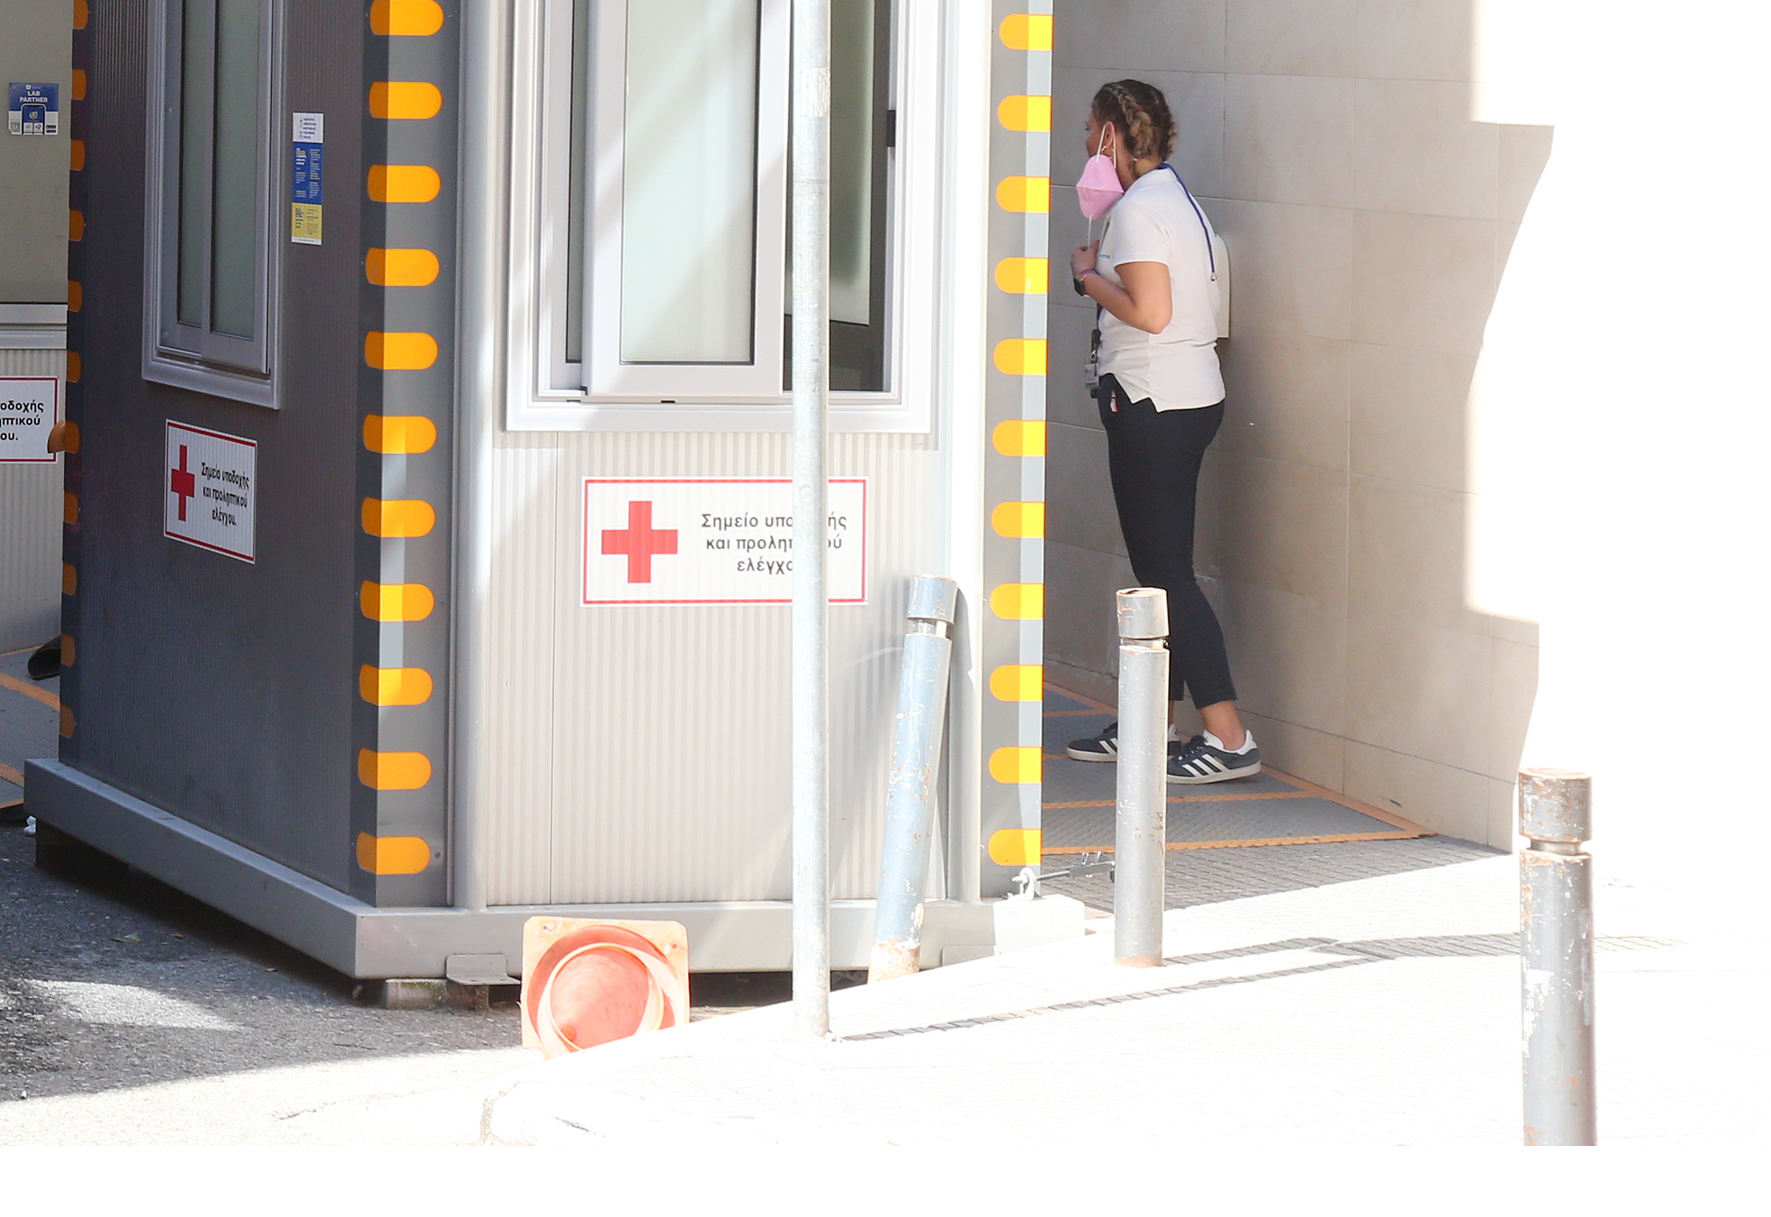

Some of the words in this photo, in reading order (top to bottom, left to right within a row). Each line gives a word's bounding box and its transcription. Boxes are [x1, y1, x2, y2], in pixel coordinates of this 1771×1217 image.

[201, 462, 221, 481] Σημείο
[221, 470, 250, 491] υποδοχής
[202, 485, 212, 497] και
[212, 488, 248, 508] προληπτικού
[212, 506, 237, 527] ελέγχου.
[701, 512, 759, 531] Σημείο
[706, 540, 731, 550] και
